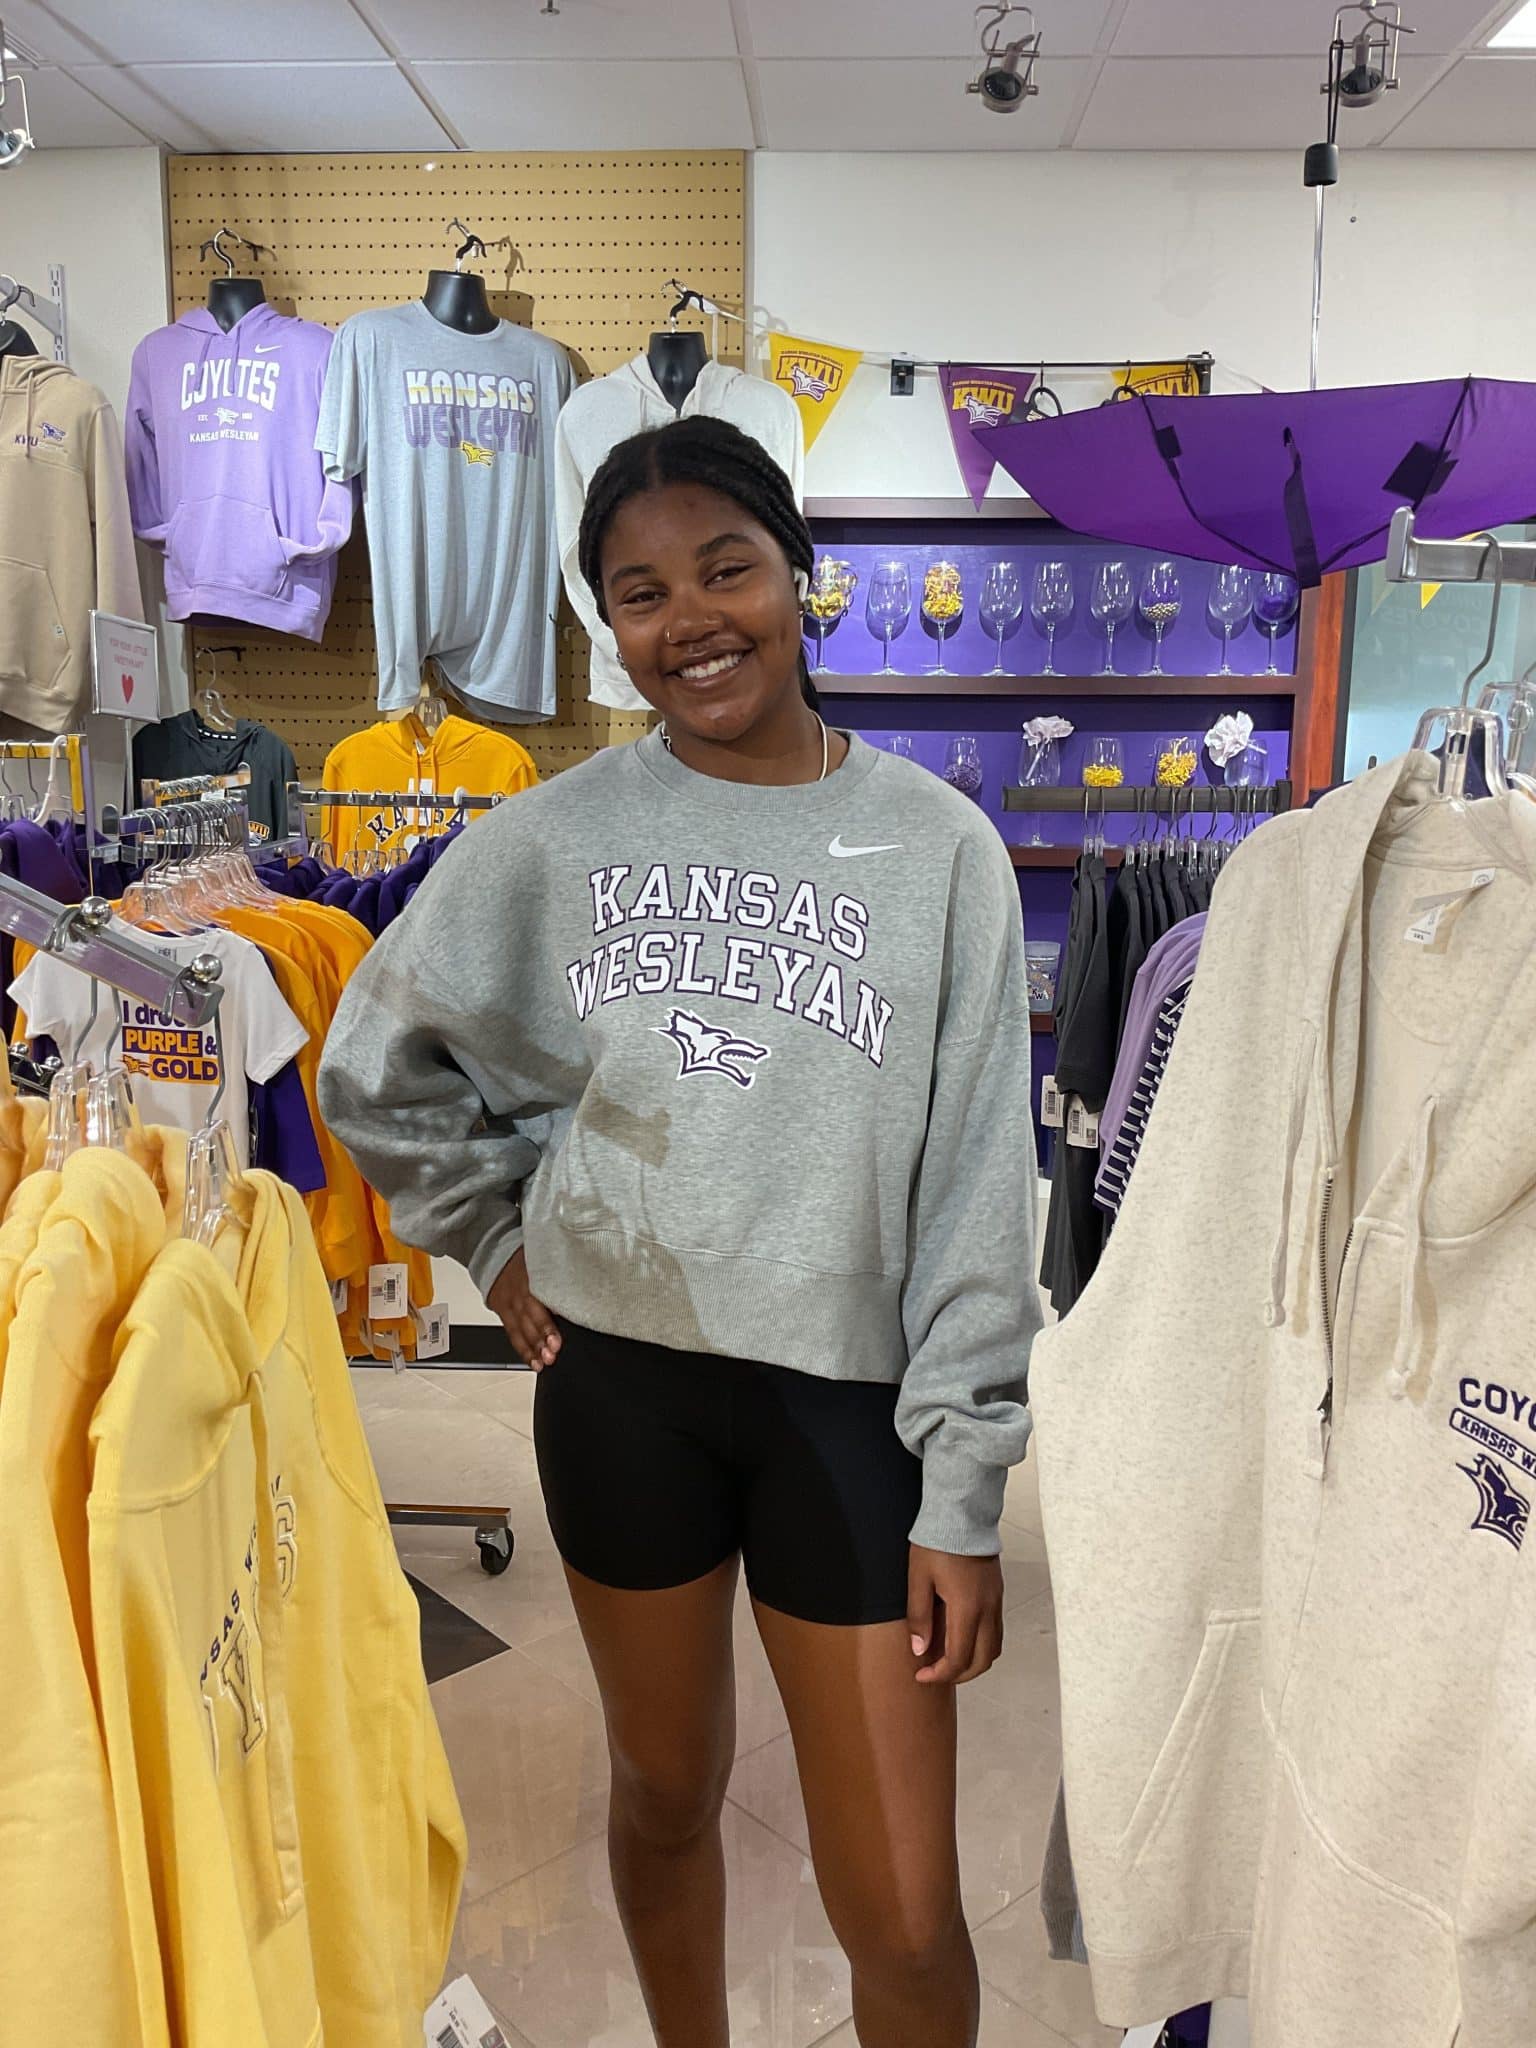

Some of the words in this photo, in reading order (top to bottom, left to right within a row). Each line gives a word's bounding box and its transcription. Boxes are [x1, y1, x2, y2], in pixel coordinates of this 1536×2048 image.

[403, 369, 535, 415] KANSAS
[402, 405, 538, 459] WESLEYAN
[589, 864, 869, 961] KANSAS
[567, 931, 894, 1069] WESLEYAN
[125, 1029, 200, 1054] PURPLE
[204, 1035, 219, 1056] &
[151, 1057, 219, 1081] GOLD
[1460, 1416, 1518, 1459] KANSAS
